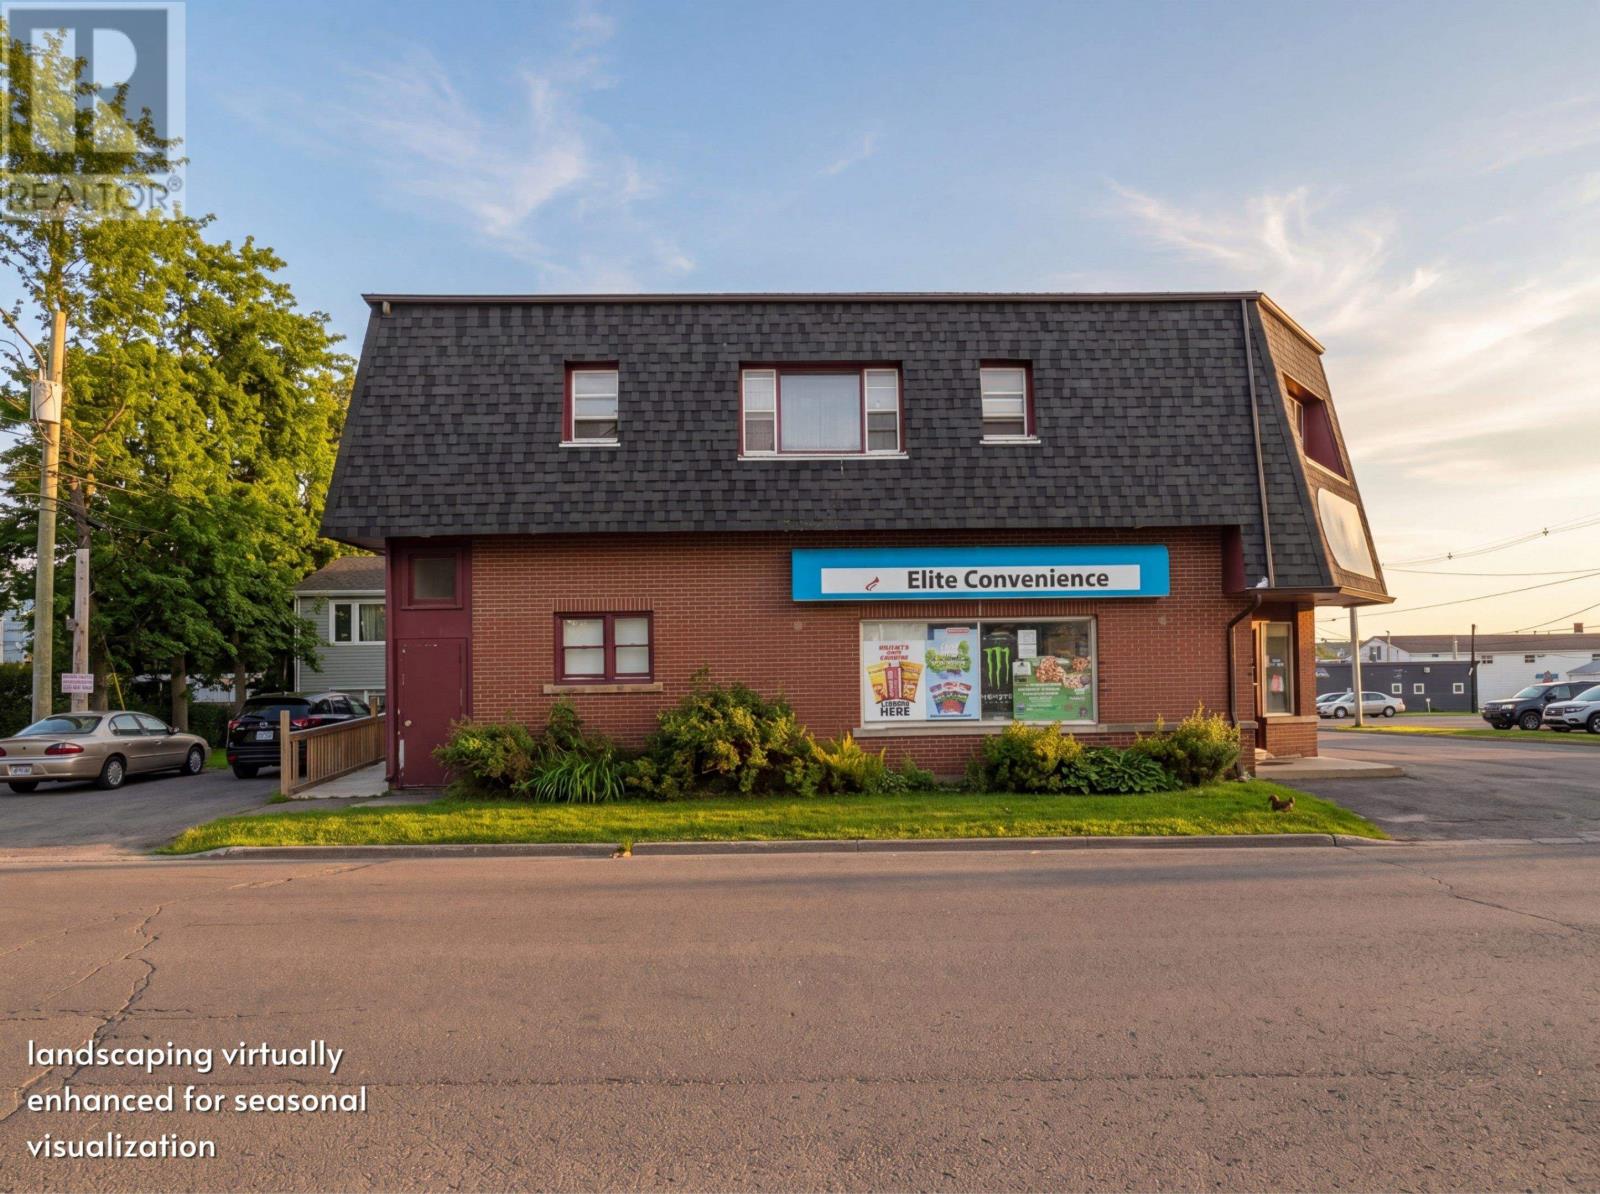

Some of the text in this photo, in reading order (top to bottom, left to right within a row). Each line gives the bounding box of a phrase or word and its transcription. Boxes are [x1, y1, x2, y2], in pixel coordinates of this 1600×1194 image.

[908, 569, 1108, 589] Elite Convenience
[880, 707, 910, 716] HERE
